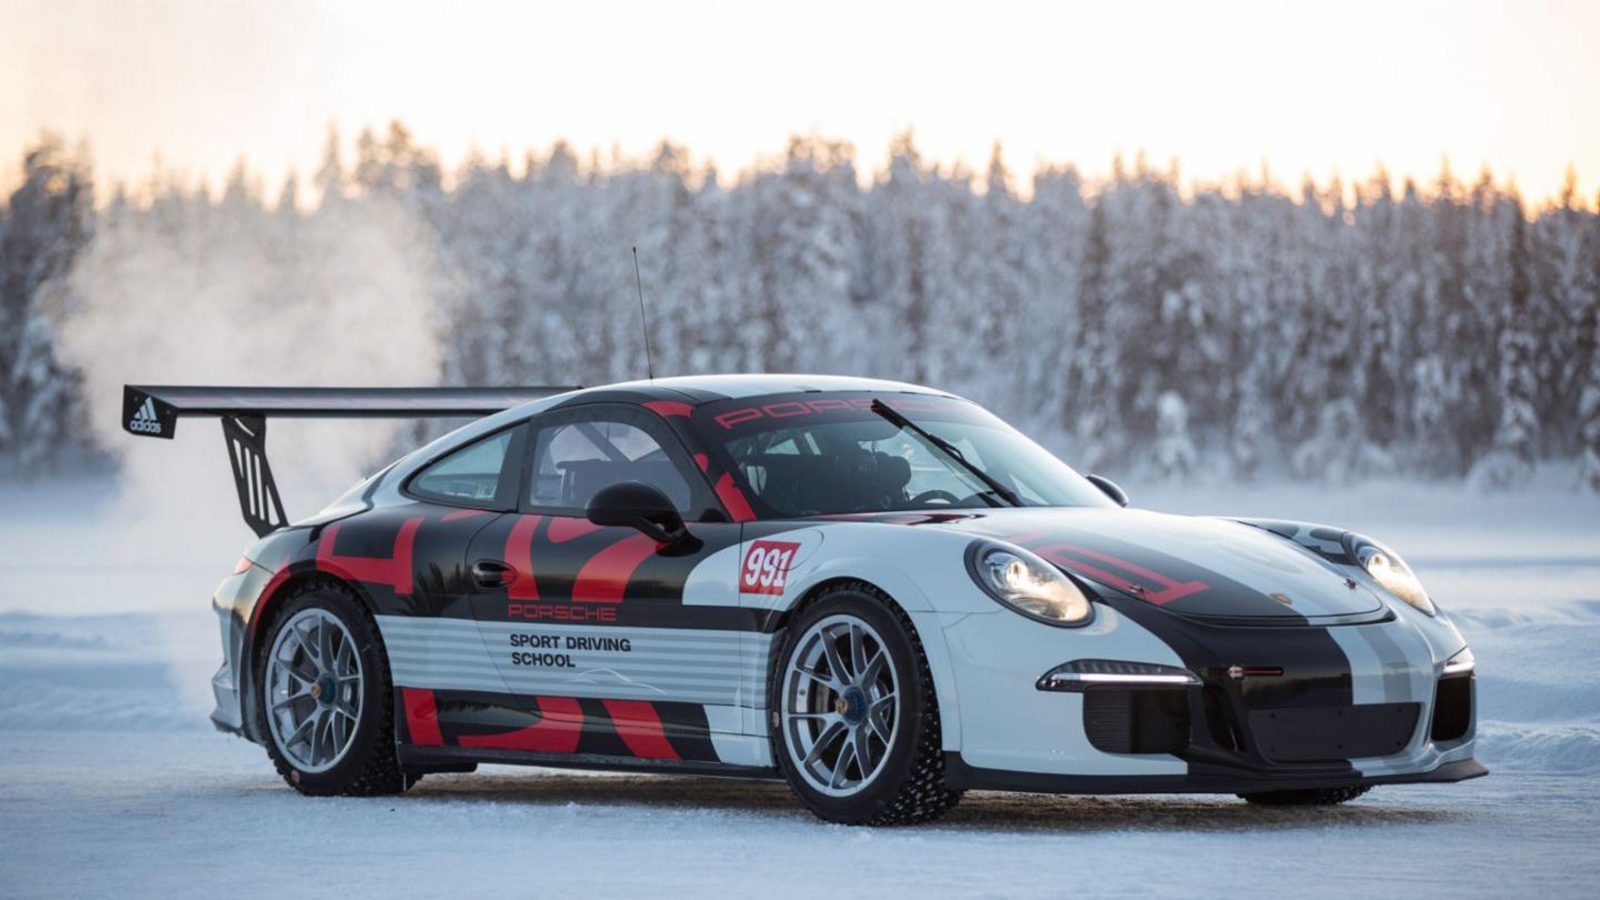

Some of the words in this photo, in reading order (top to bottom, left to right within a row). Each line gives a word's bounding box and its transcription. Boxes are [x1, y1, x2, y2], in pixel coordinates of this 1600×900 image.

[713, 398, 968, 430] PORC
[130, 419, 161, 433] adidas
[745, 547, 792, 587] 991
[508, 604, 617, 621] PORSCHE
[510, 633, 560, 649] SPORT
[566, 636, 632, 652] DRIVING
[511, 651, 576, 668] SCHOOL
